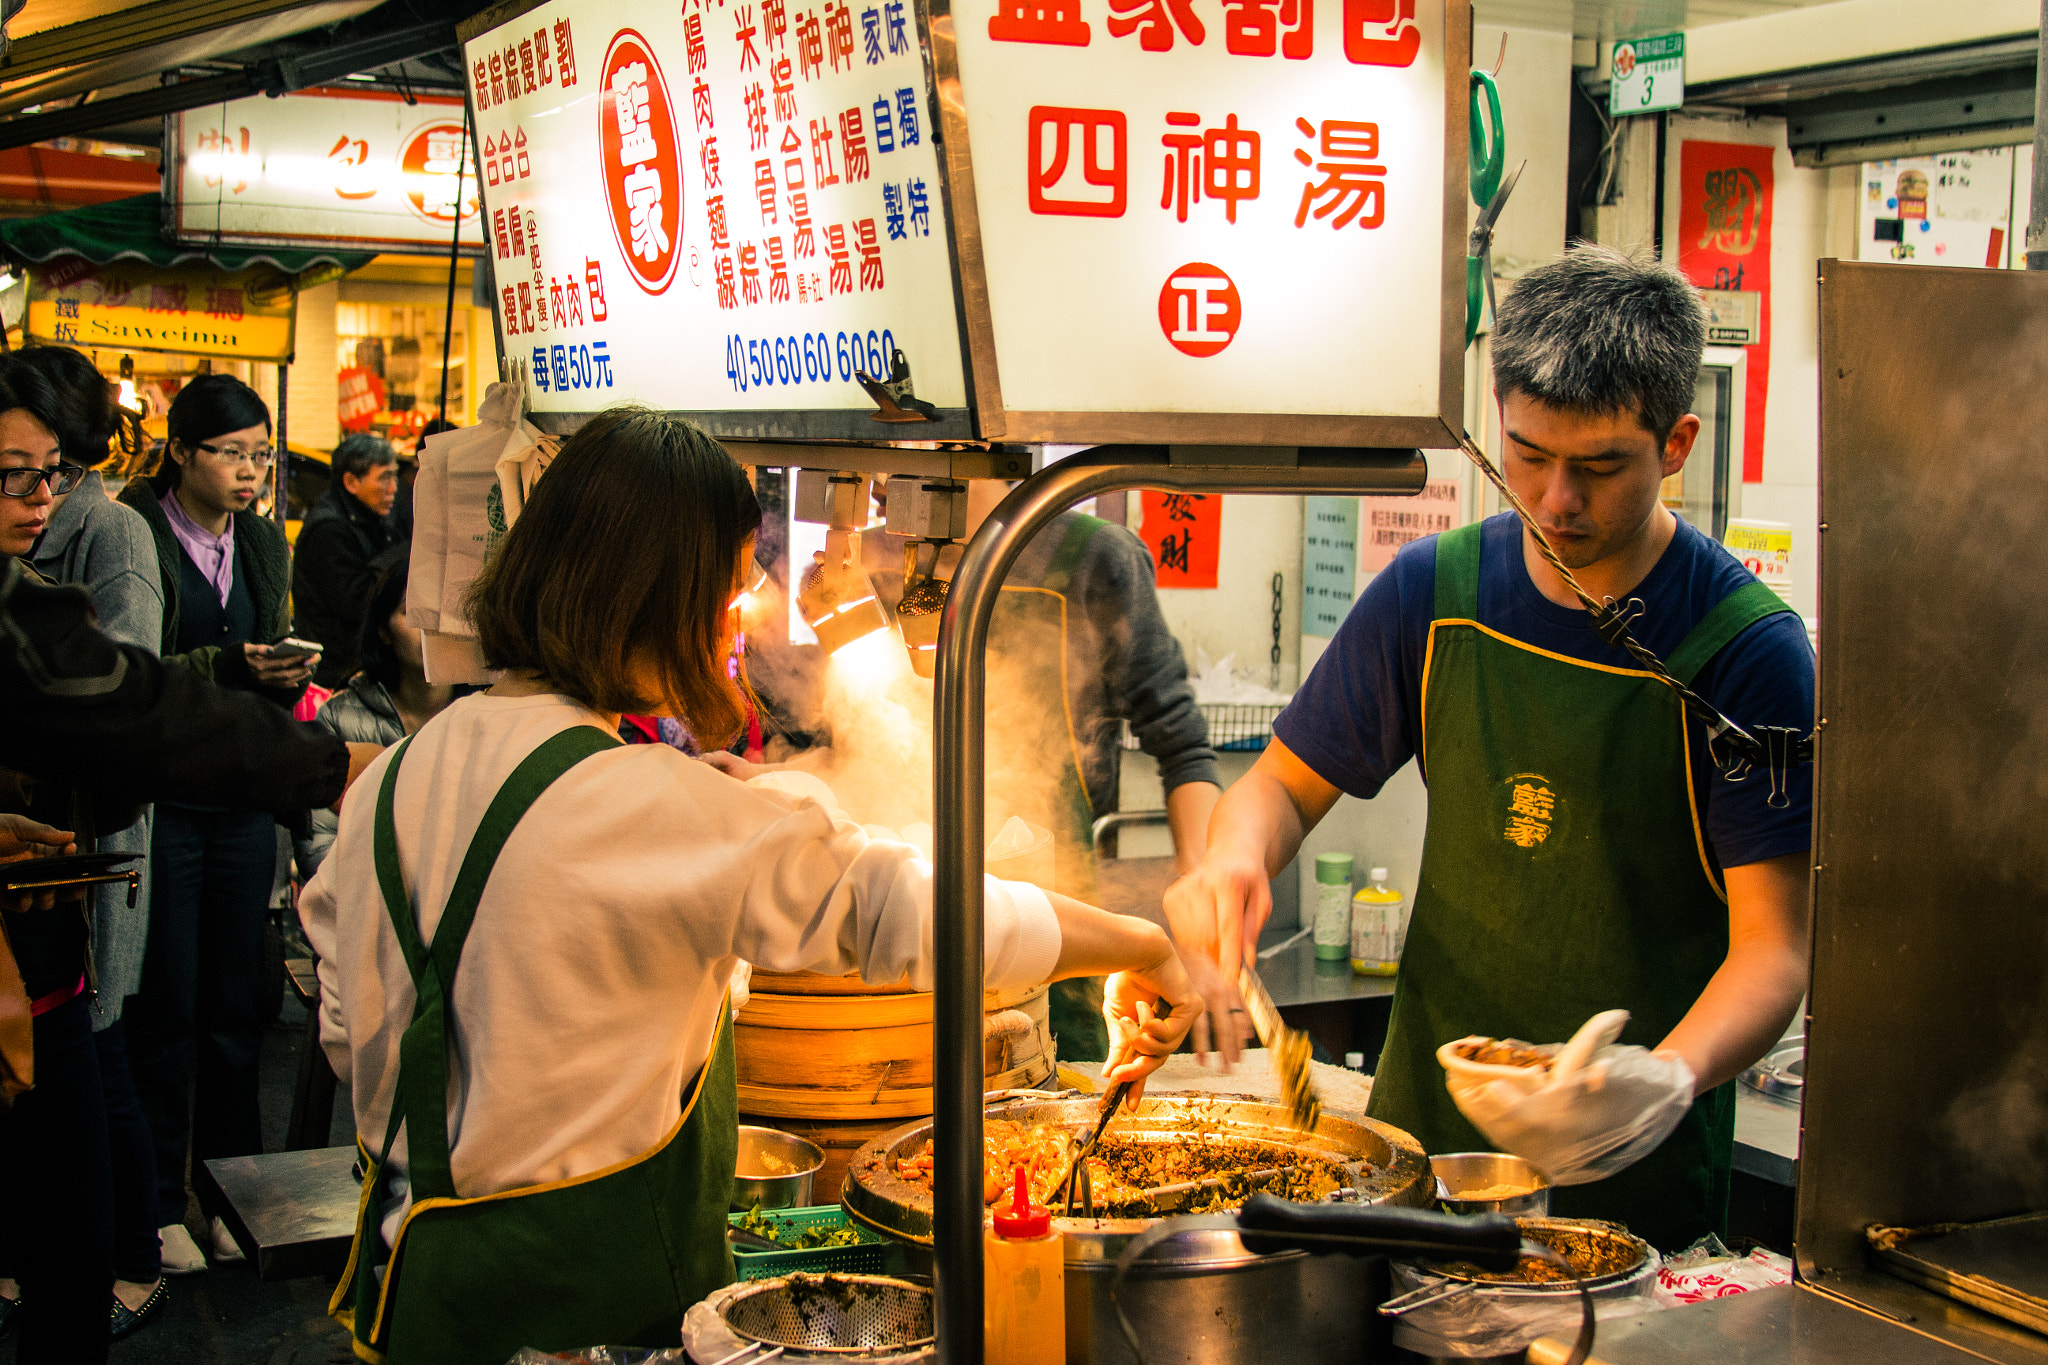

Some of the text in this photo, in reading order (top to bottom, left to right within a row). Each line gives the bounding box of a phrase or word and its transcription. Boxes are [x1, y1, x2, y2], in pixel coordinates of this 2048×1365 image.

[1641, 75, 1654, 105] 3
[611, 61, 671, 263] 藍家
[1028, 105, 1388, 230] 四神湯
[91, 317, 239, 347] Saweima
[1169, 276, 1231, 343] 正
[532, 341, 613, 393] 每個50元
[727, 328, 896, 392] 40 50 60 60 60 60
